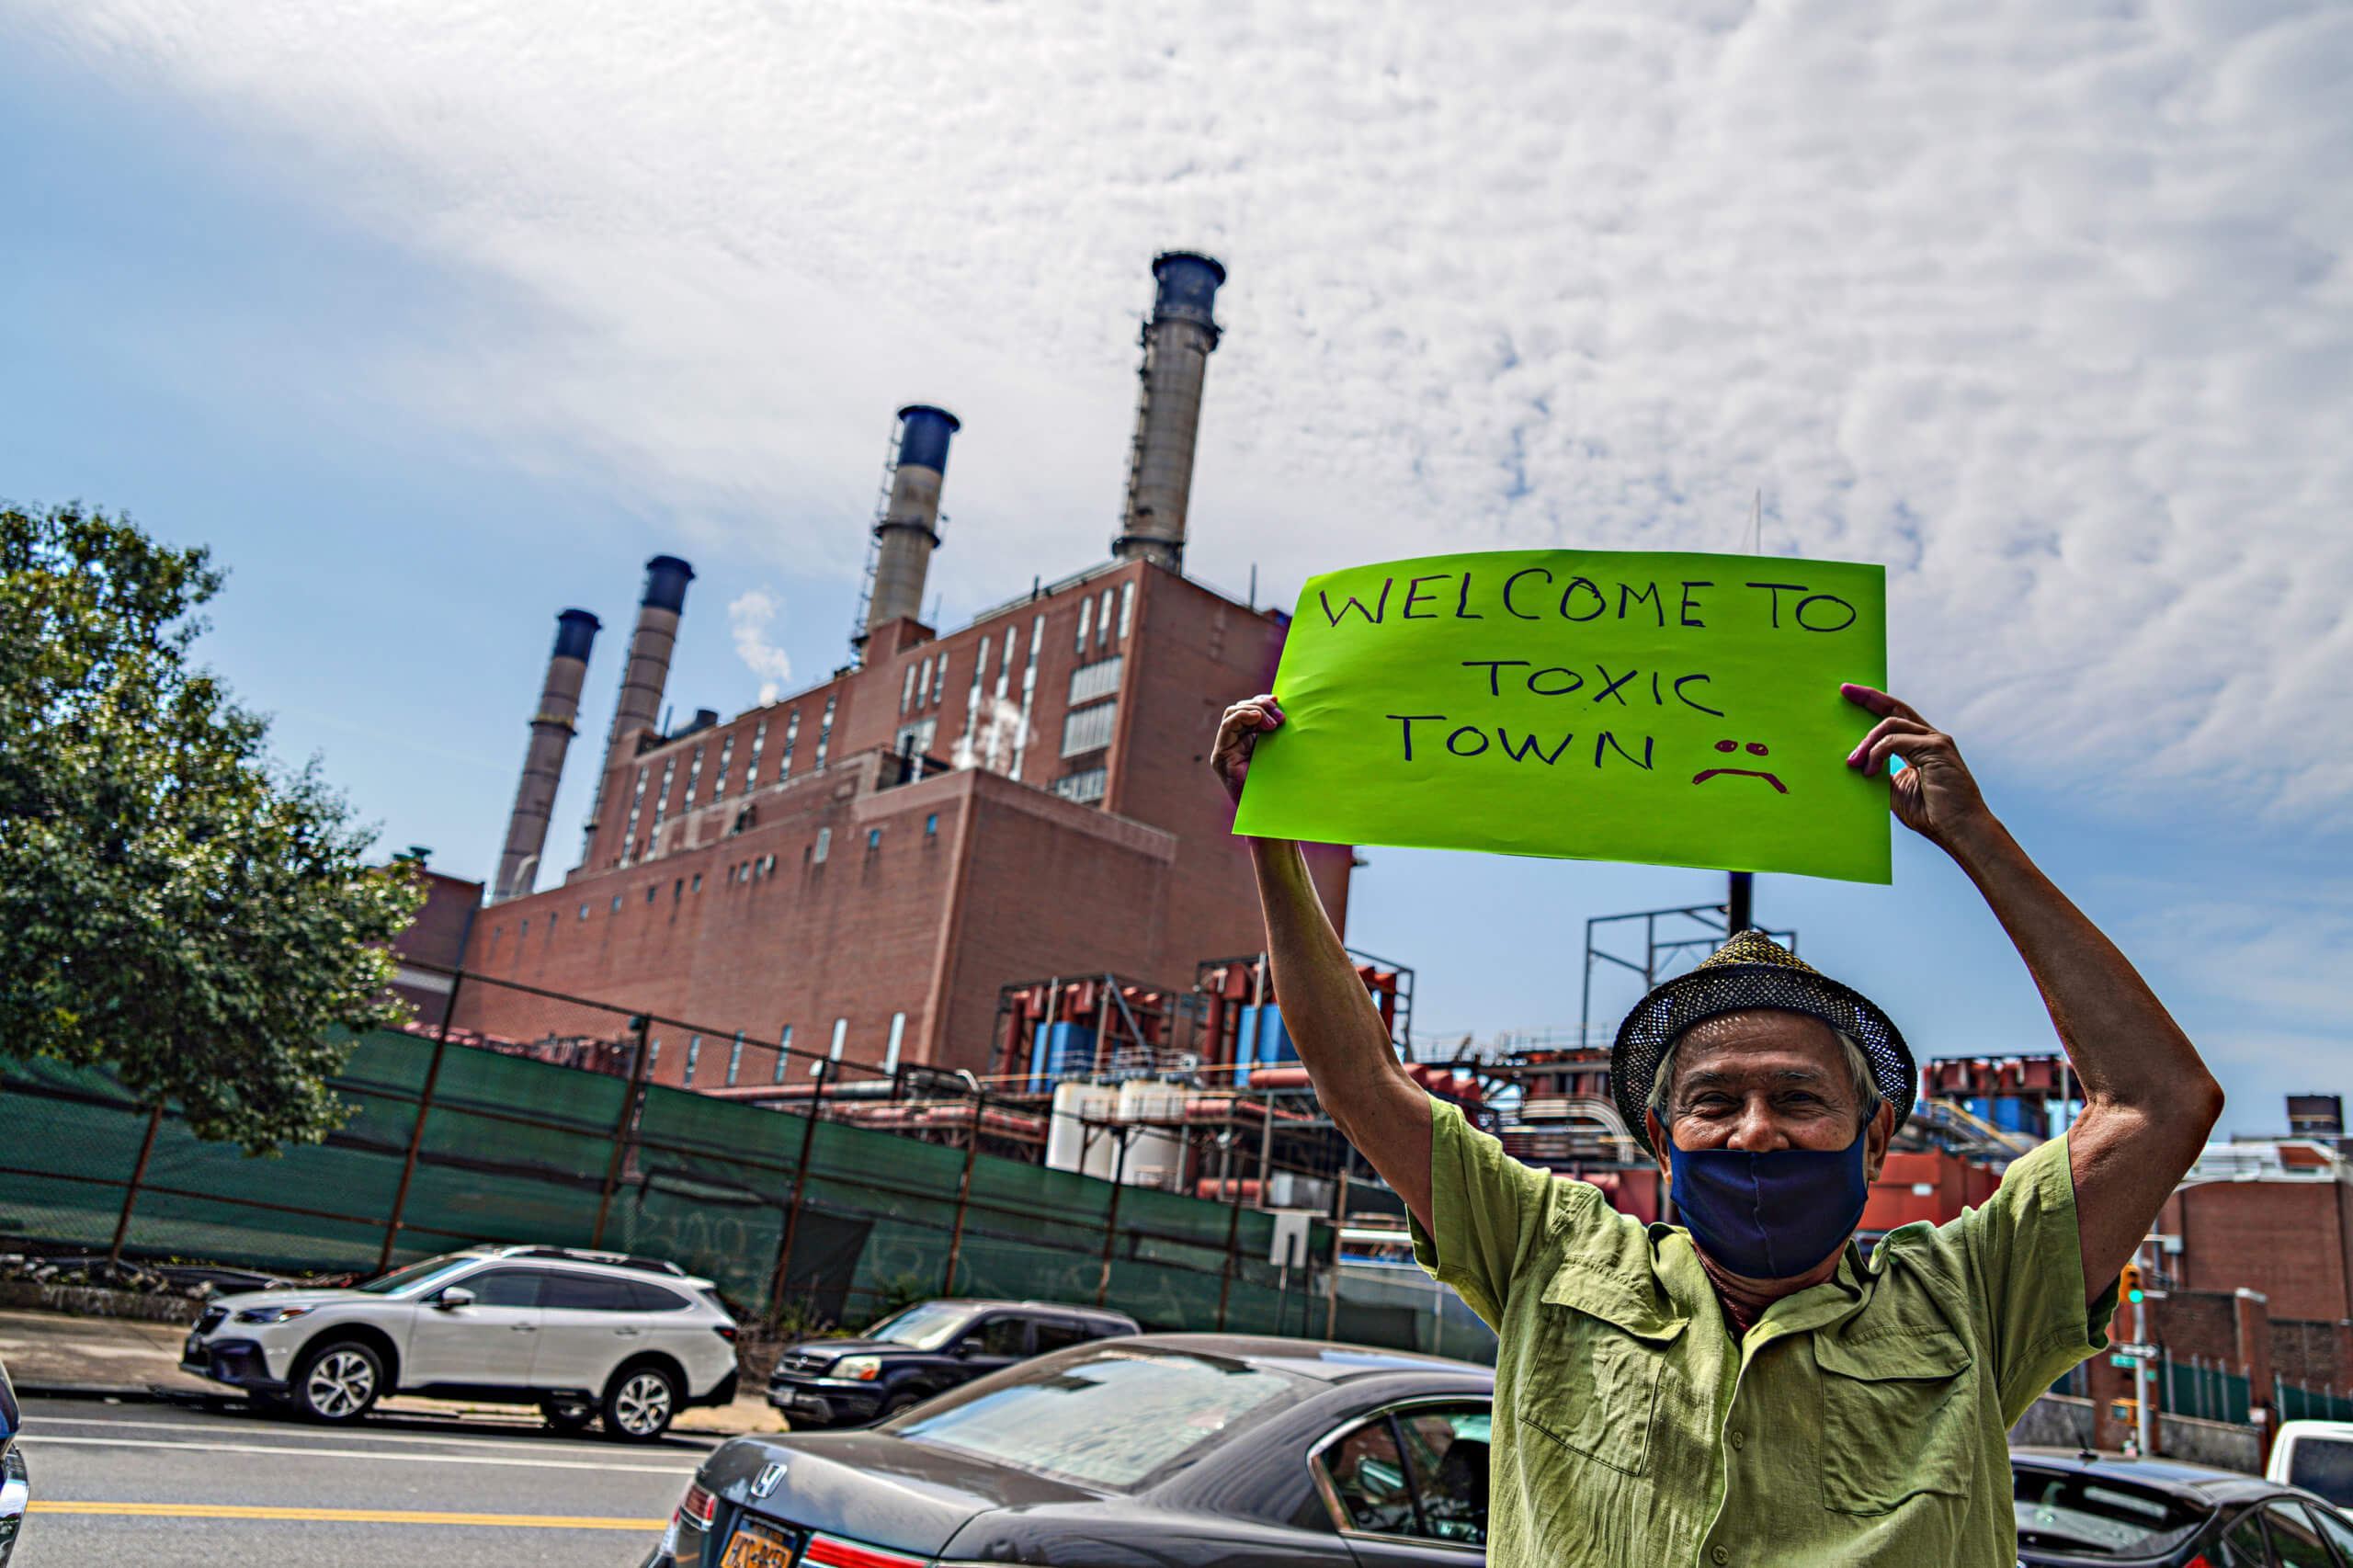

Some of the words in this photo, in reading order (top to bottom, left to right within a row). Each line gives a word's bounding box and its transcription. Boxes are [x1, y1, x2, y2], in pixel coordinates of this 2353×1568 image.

[1320, 568, 1715, 629] WELCOME
[1745, 582, 1858, 633] TO
[1461, 661, 1725, 718] TOXIC
[1386, 715, 1654, 771] TOWN
